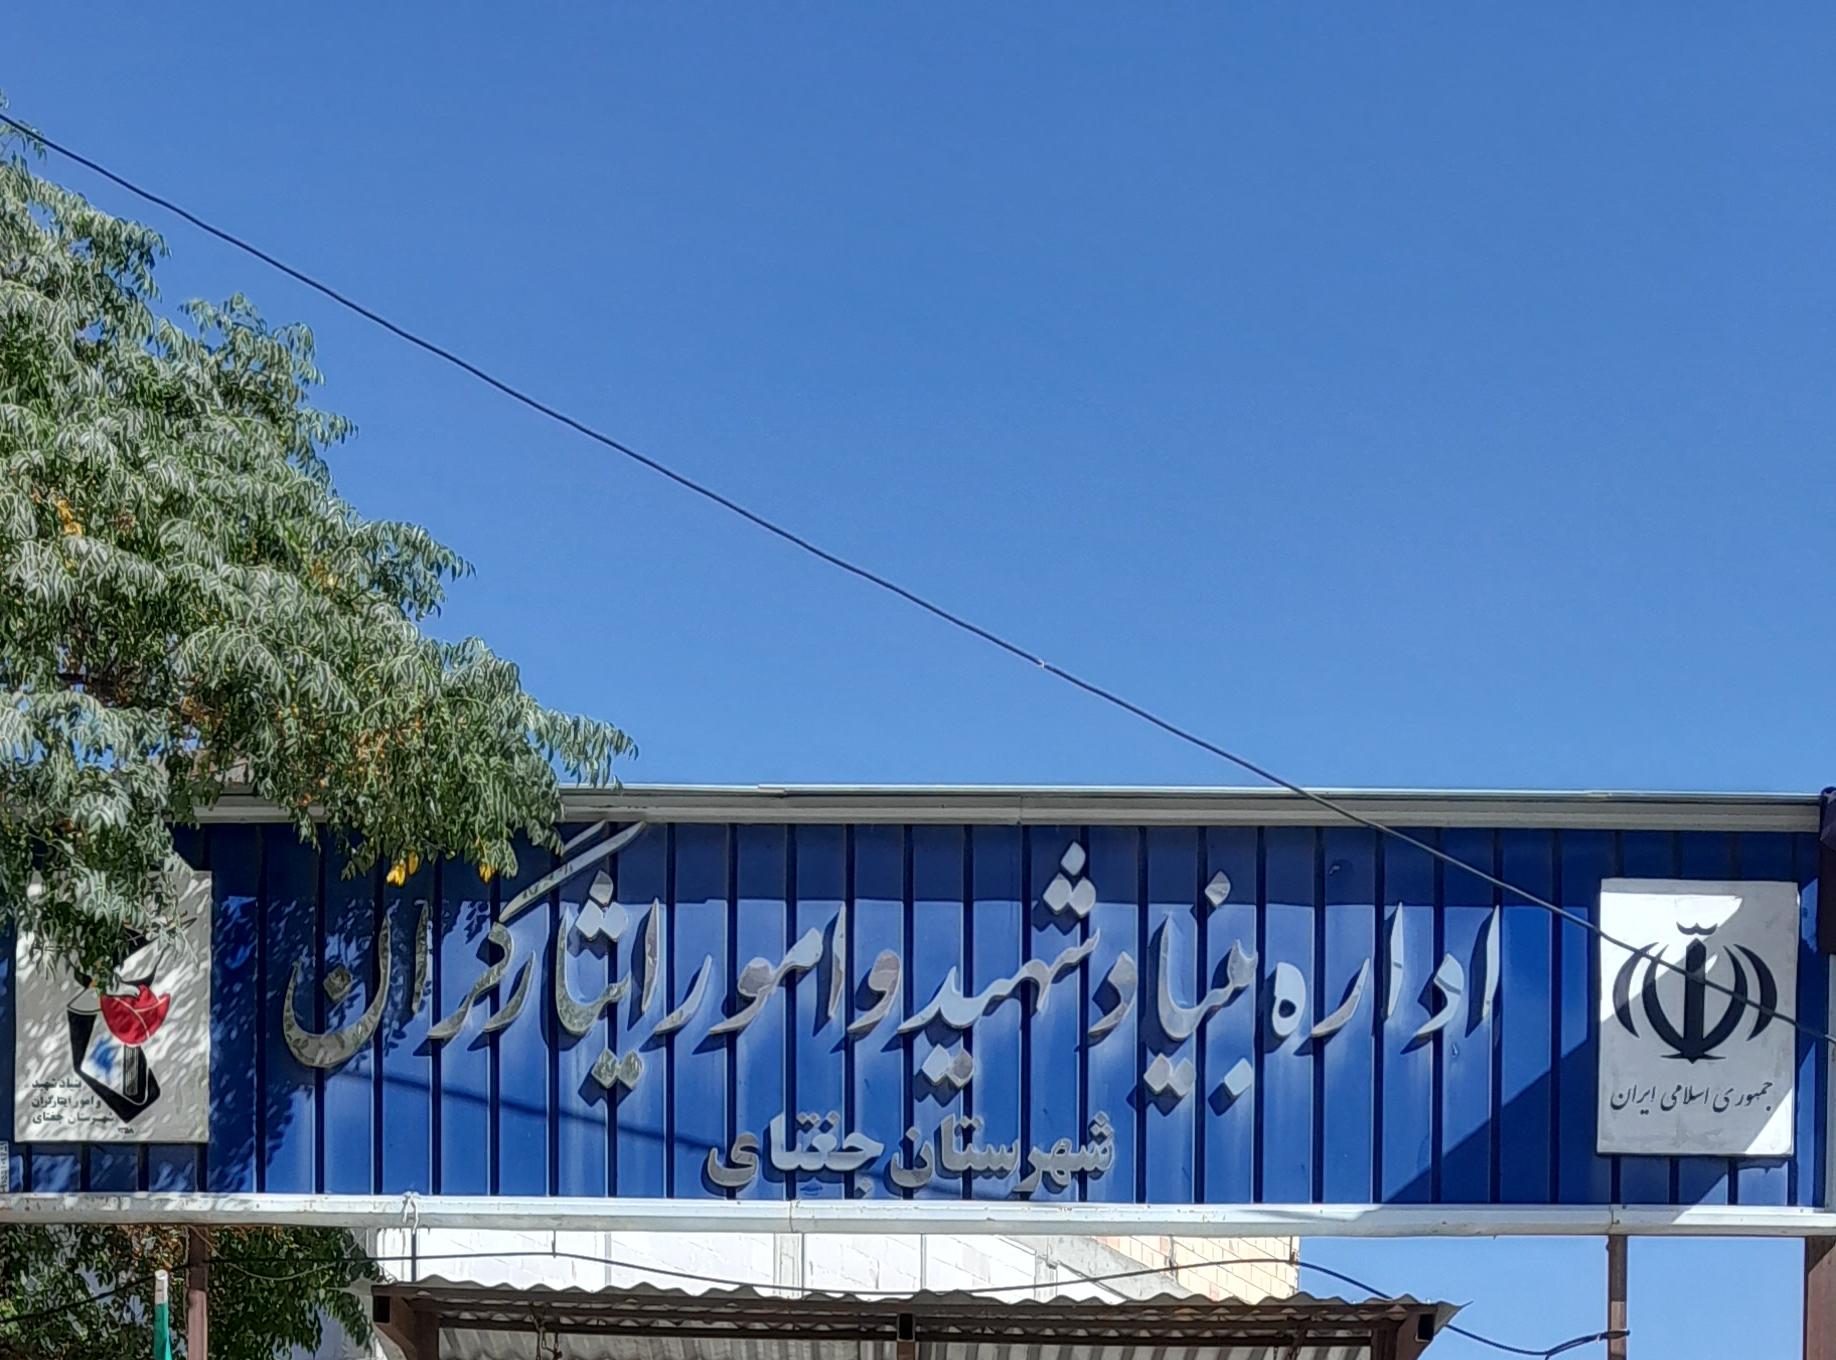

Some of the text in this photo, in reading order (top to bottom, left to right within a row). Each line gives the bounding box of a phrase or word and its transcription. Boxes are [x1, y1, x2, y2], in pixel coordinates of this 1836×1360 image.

[282, 821, 1500, 1099] اداره بنیاد شهید و امور ایثارگران
[1610, 1081, 1773, 1115] جمهوری اسلامی ایران
[707, 1110, 1116, 1199] شهرستان جغتای
